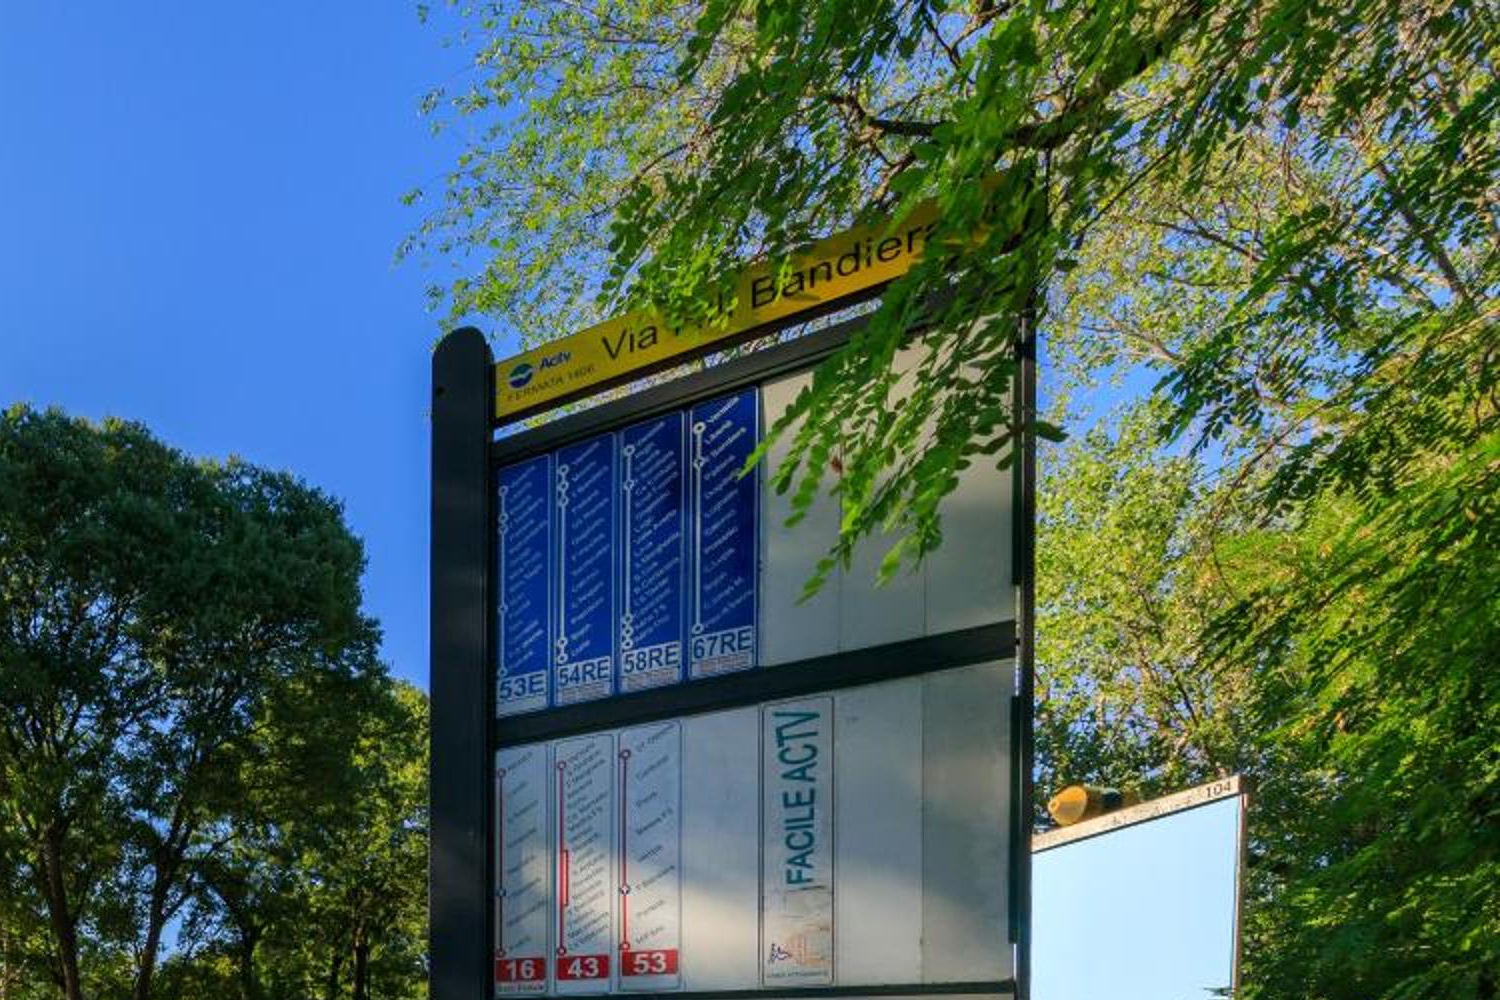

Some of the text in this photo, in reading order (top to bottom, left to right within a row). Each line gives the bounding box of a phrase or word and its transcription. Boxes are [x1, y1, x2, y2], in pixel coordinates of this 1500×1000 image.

[602, 325, 658, 360] Via
[693, 629, 752, 659] 67RE
[558, 658, 610, 687] 54RE
[622, 644, 679, 674] 58RE
[499, 673, 544, 699] 53E
[772, 711, 820, 885] FACILE ACTV
[505, 959, 536, 981] 16
[567, 956, 599, 978] 43
[633, 952, 668, 974] 53
